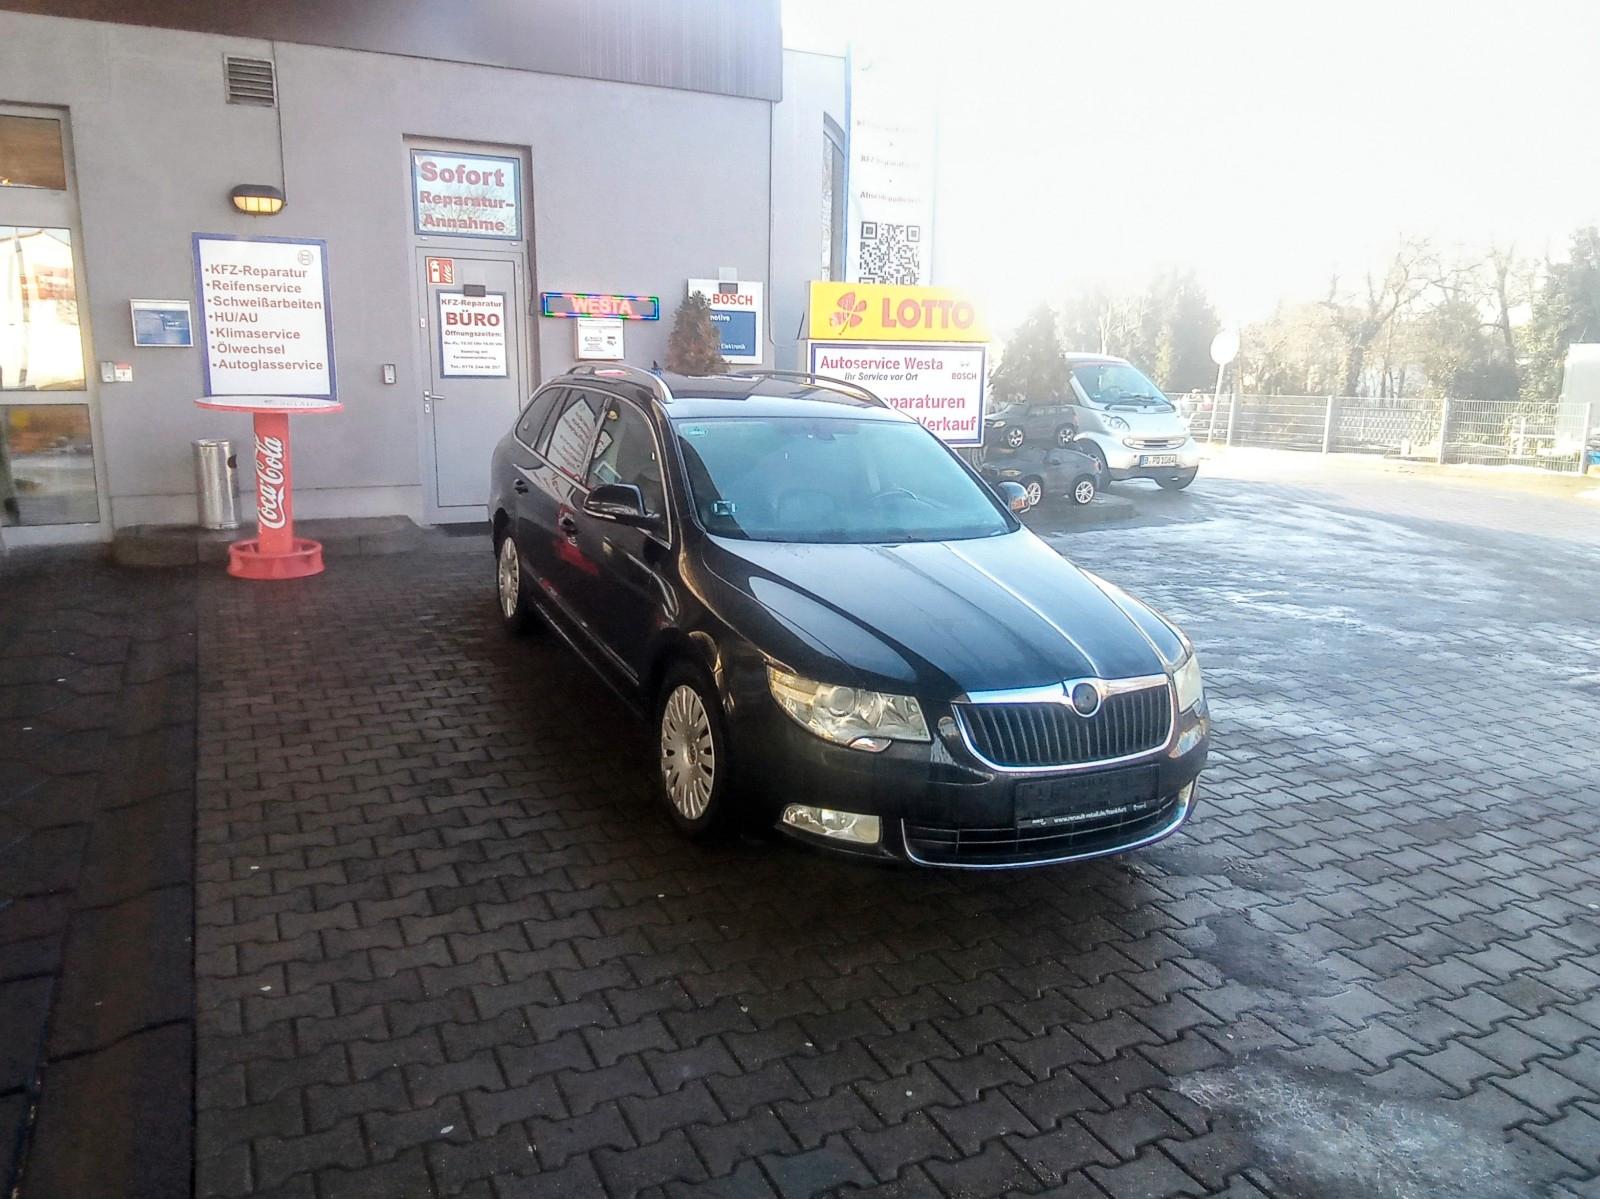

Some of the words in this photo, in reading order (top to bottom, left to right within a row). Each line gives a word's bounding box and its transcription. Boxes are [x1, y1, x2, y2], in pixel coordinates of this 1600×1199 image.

[420, 161, 505, 187] Sofort
[419, 191, 514, 209] Reparatur-
[423, 215, 505, 231] Annahme
[211, 264, 308, 279] KFZ-Reparatur
[212, 280, 302, 293] Reifenservice
[213, 296, 322, 310] Schweißarbeiten
[441, 298, 502, 307] KFZ-Reparatur
[571, 297, 632, 314] WESTA
[712, 294, 753, 305] BOSCH
[215, 311, 258, 323] HU/AU
[446, 309, 500, 326] BÜRO
[881, 297, 976, 329] LOTTO
[216, 328, 300, 339] Klimaservice
[445, 329, 502, 337] Öffnungszeiten:
[217, 341, 285, 354] Ölwechsel
[218, 359, 323, 371] Autoglasservice
[820, 355, 900, 370] Autoservice
[904, 356, 943, 370] Westa
[845, 371, 856, 381] Ihr
[858, 372, 888, 381] Service
[890, 373, 903, 381] vor
[905, 373, 918, 381] Ort
[951, 372, 977, 380] BOSCH
[887, 395, 965, 412] paraturen
